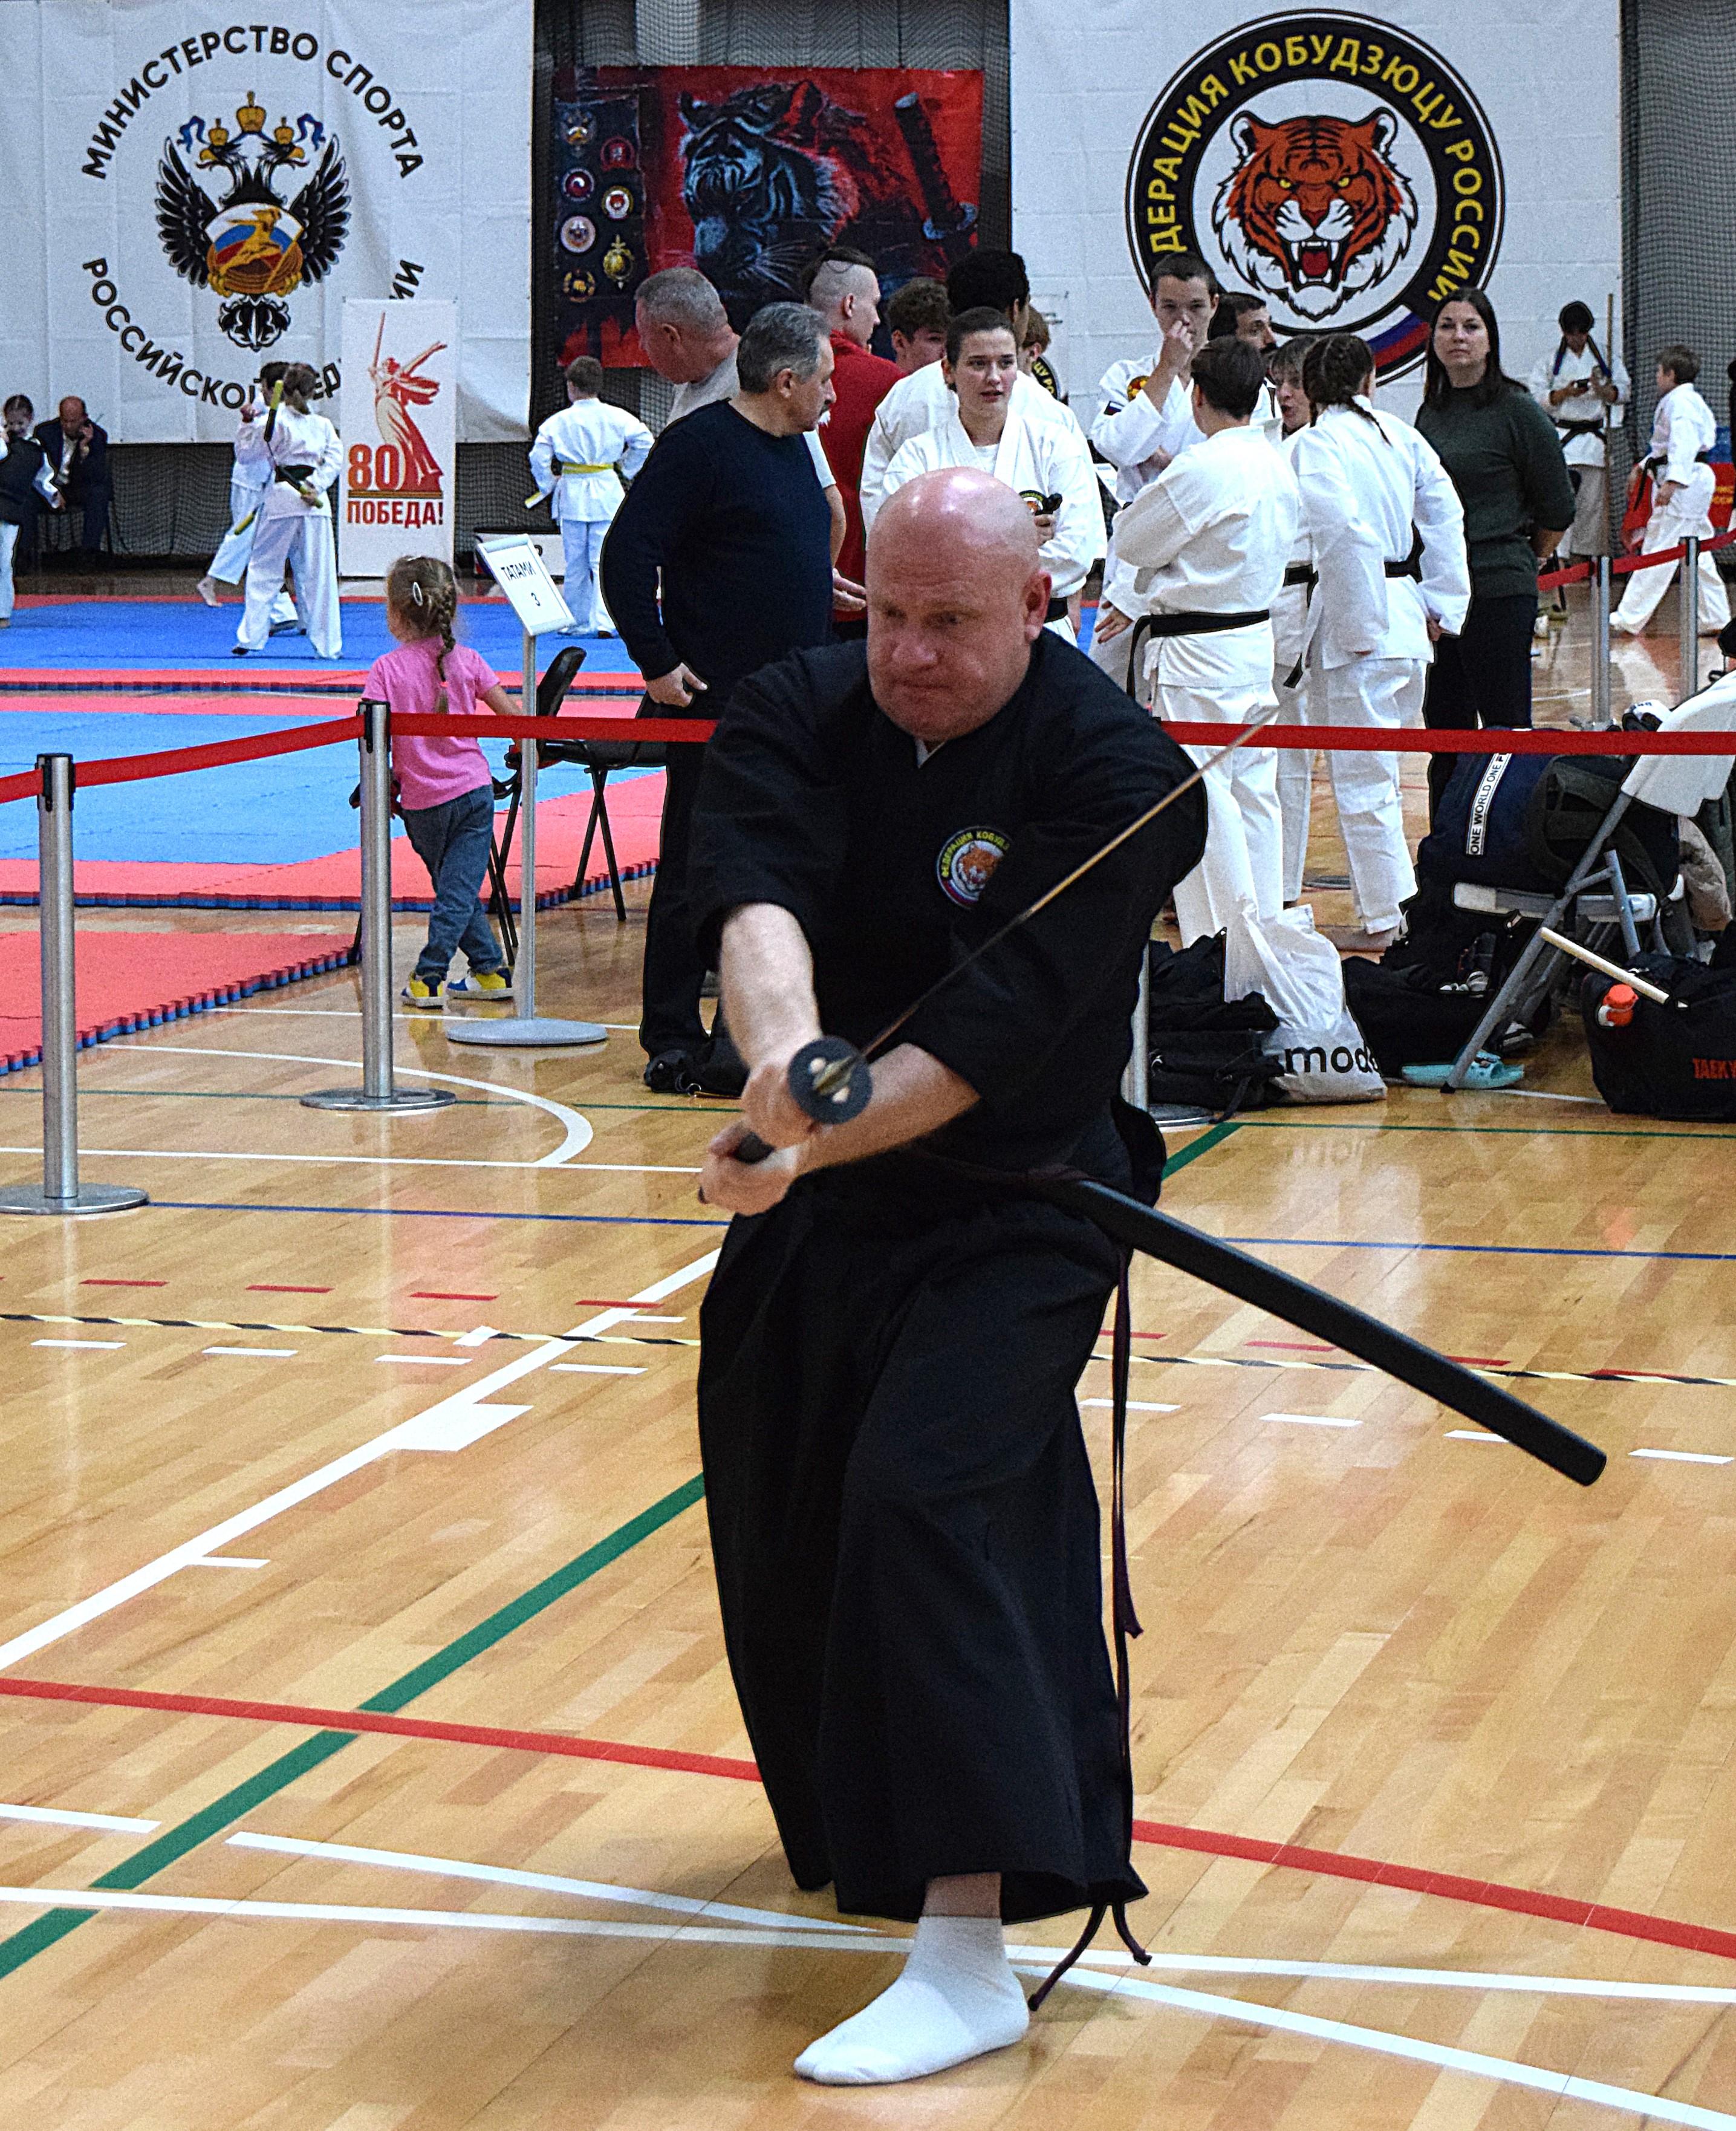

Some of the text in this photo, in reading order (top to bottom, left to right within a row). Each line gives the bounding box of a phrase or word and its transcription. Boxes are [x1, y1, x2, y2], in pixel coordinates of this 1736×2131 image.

[82, 25, 424, 179] МИНИСТЕРСТВО СПОРТА
[1146, 73, 1229, 253] ДЕРАЦИЯ
[1228, 34, 1463, 129] КОБУДЗЮЦУ
[348, 443, 400, 491] 80
[347, 500, 444, 529] ПОБЕДА!
[501, 561, 536, 581] ТАТАМИ
[531, 592, 541, 607] 3
[1486, 764, 1502, 782] ONE
[1474, 785, 1492, 825] WORLD
[1470, 828, 1481, 854] ONE
